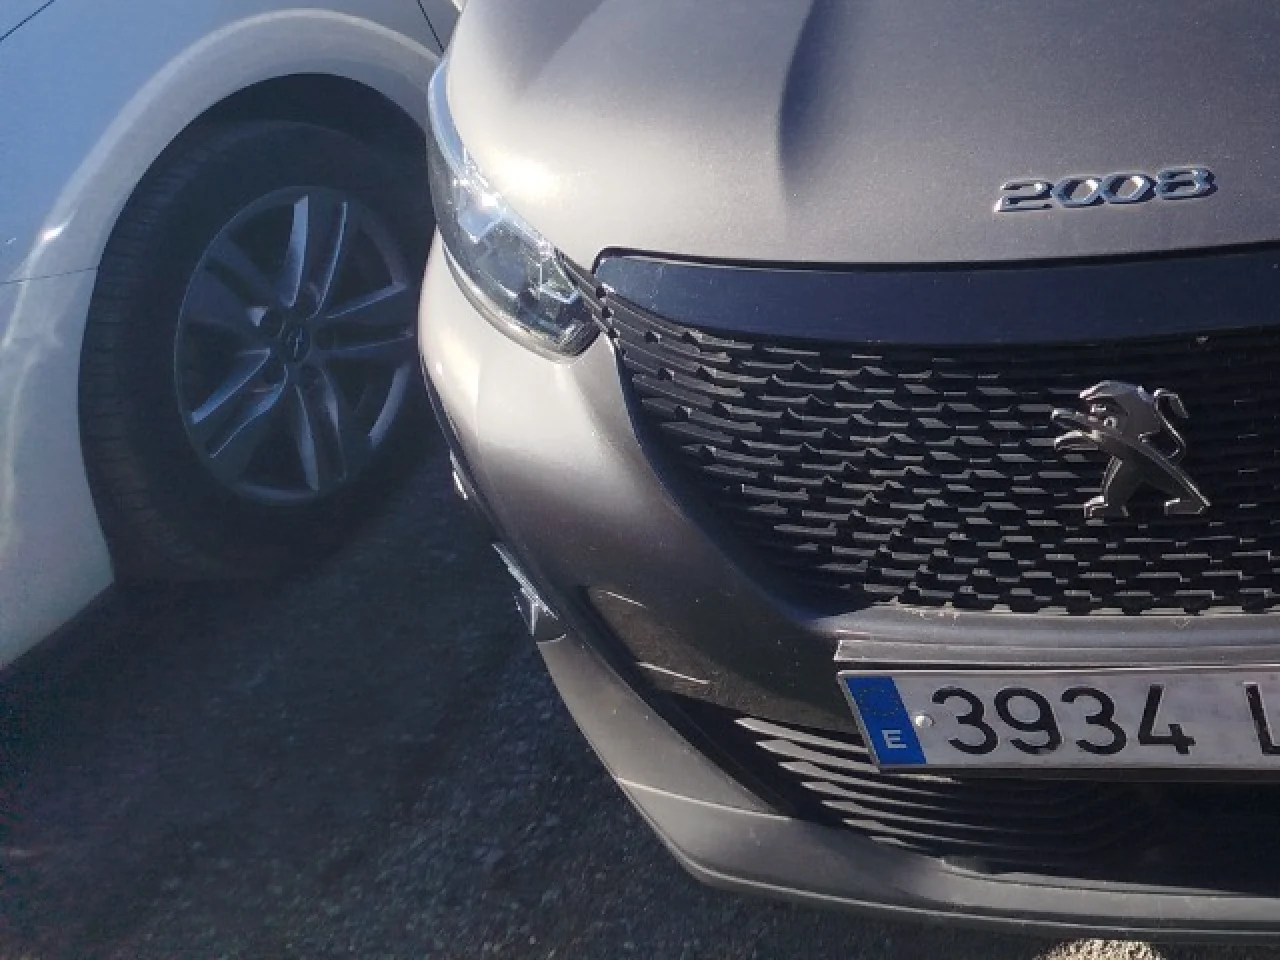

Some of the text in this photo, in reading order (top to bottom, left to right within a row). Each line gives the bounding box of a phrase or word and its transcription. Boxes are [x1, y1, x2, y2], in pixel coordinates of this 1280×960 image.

[993, 166, 1218, 213] 2008
[881, 729, 907, 749] E
[931, 683, 1197, 756] 3934
